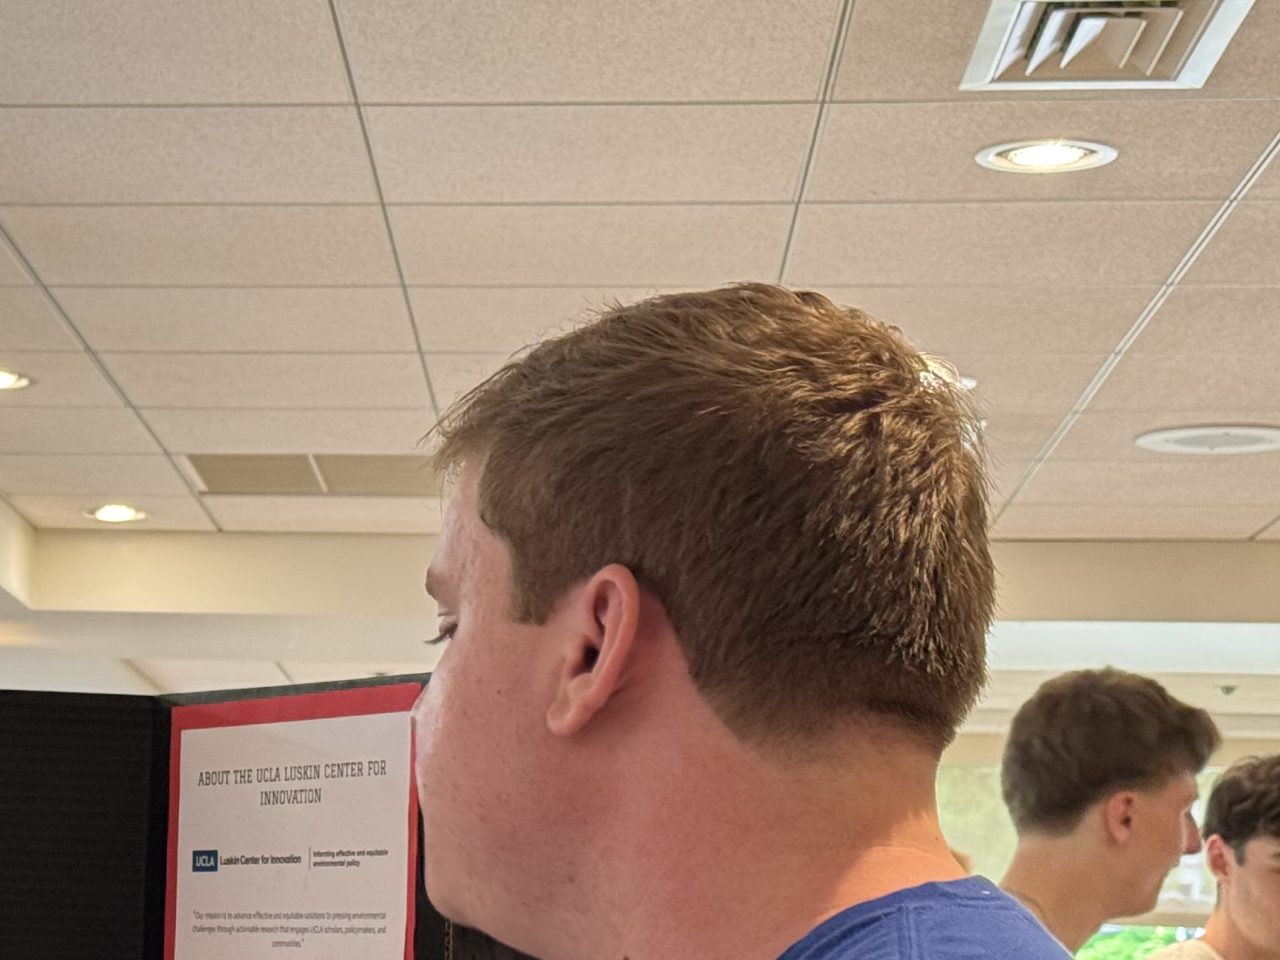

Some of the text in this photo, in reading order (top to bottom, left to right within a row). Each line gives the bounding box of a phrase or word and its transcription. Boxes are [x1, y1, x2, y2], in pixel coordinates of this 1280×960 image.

[198, 760, 387, 787] ABOUT THE UCLA LUSKIN CENTER FOR
[260, 788, 322, 806] INNOVATION
[196, 854, 301, 867] UCLA Luskin Center for Innovation
